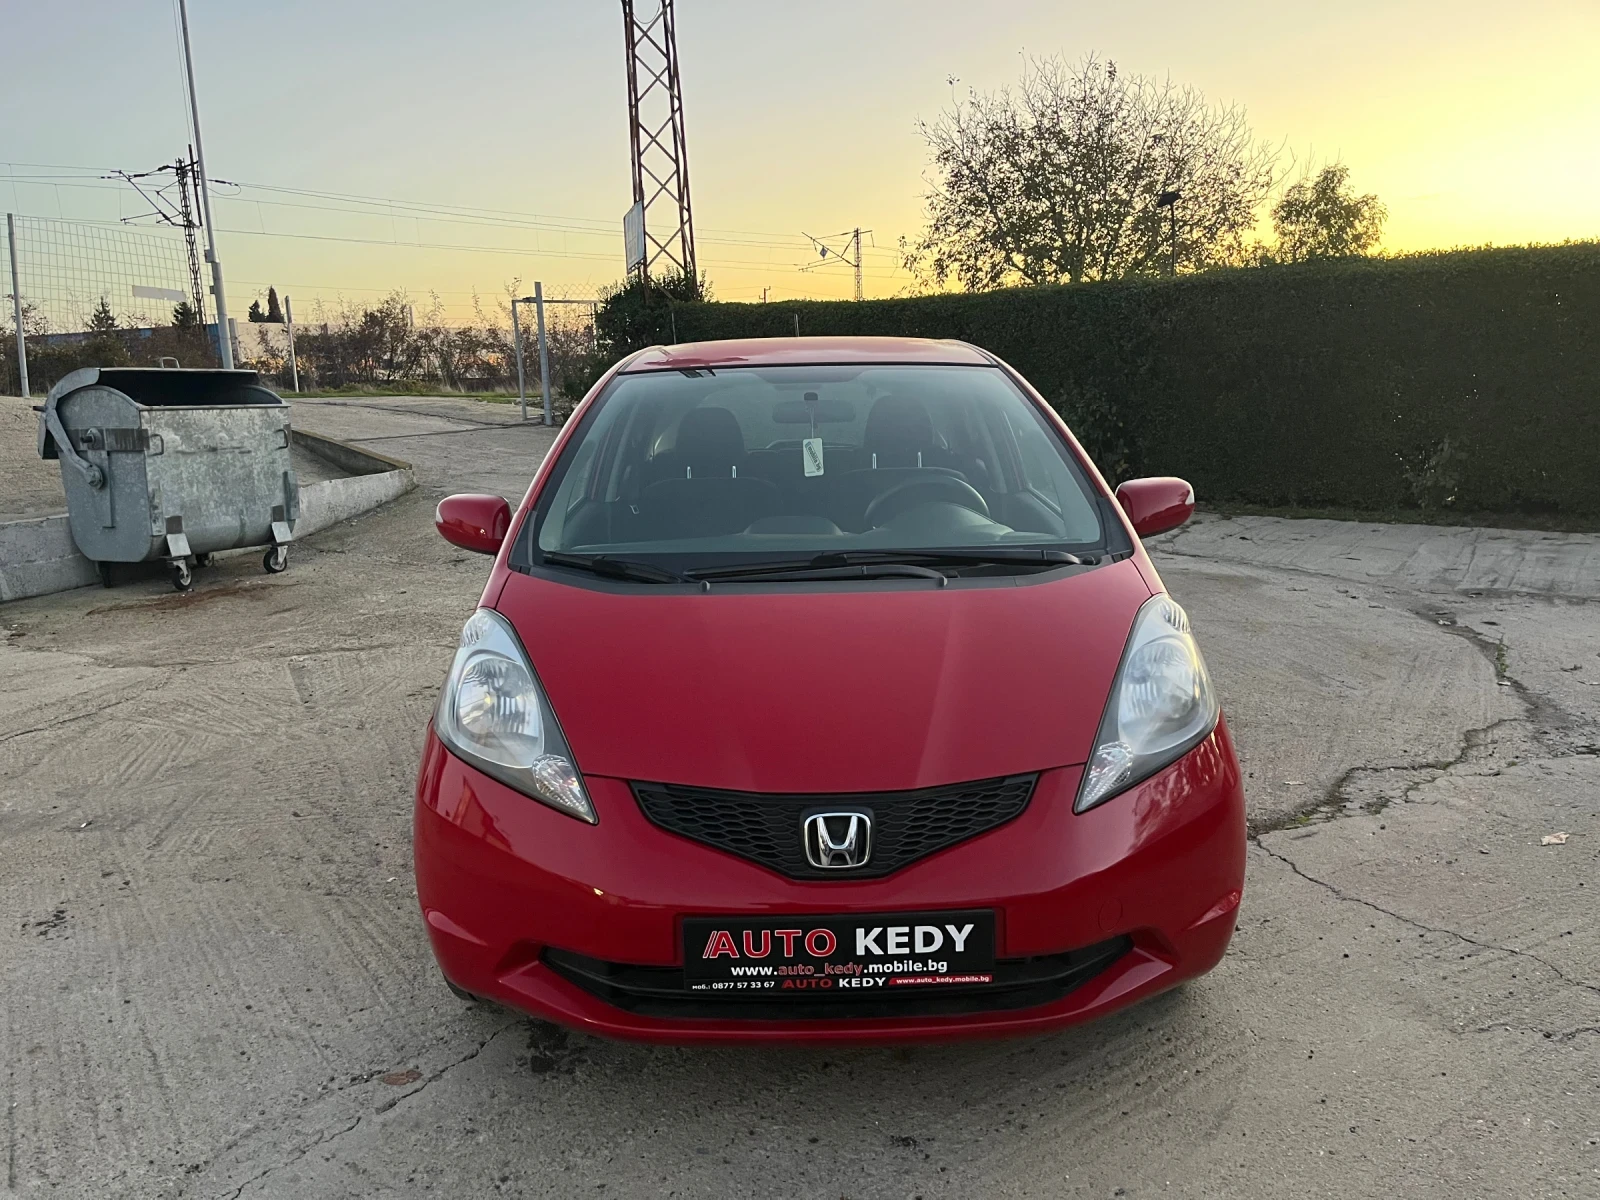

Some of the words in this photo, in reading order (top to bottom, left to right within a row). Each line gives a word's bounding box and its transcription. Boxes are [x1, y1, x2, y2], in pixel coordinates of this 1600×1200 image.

[703, 929, 837, 958] AUTO
[855, 924, 974, 956] KEDY
[731, 959, 948, 976] www.auto_kedy.mobile.bg
[782, 979, 832, 988] AUTO
[838, 977, 886, 988] KEDY
[896, 975, 989, 984] www.auto_kedy.mobile.bg
